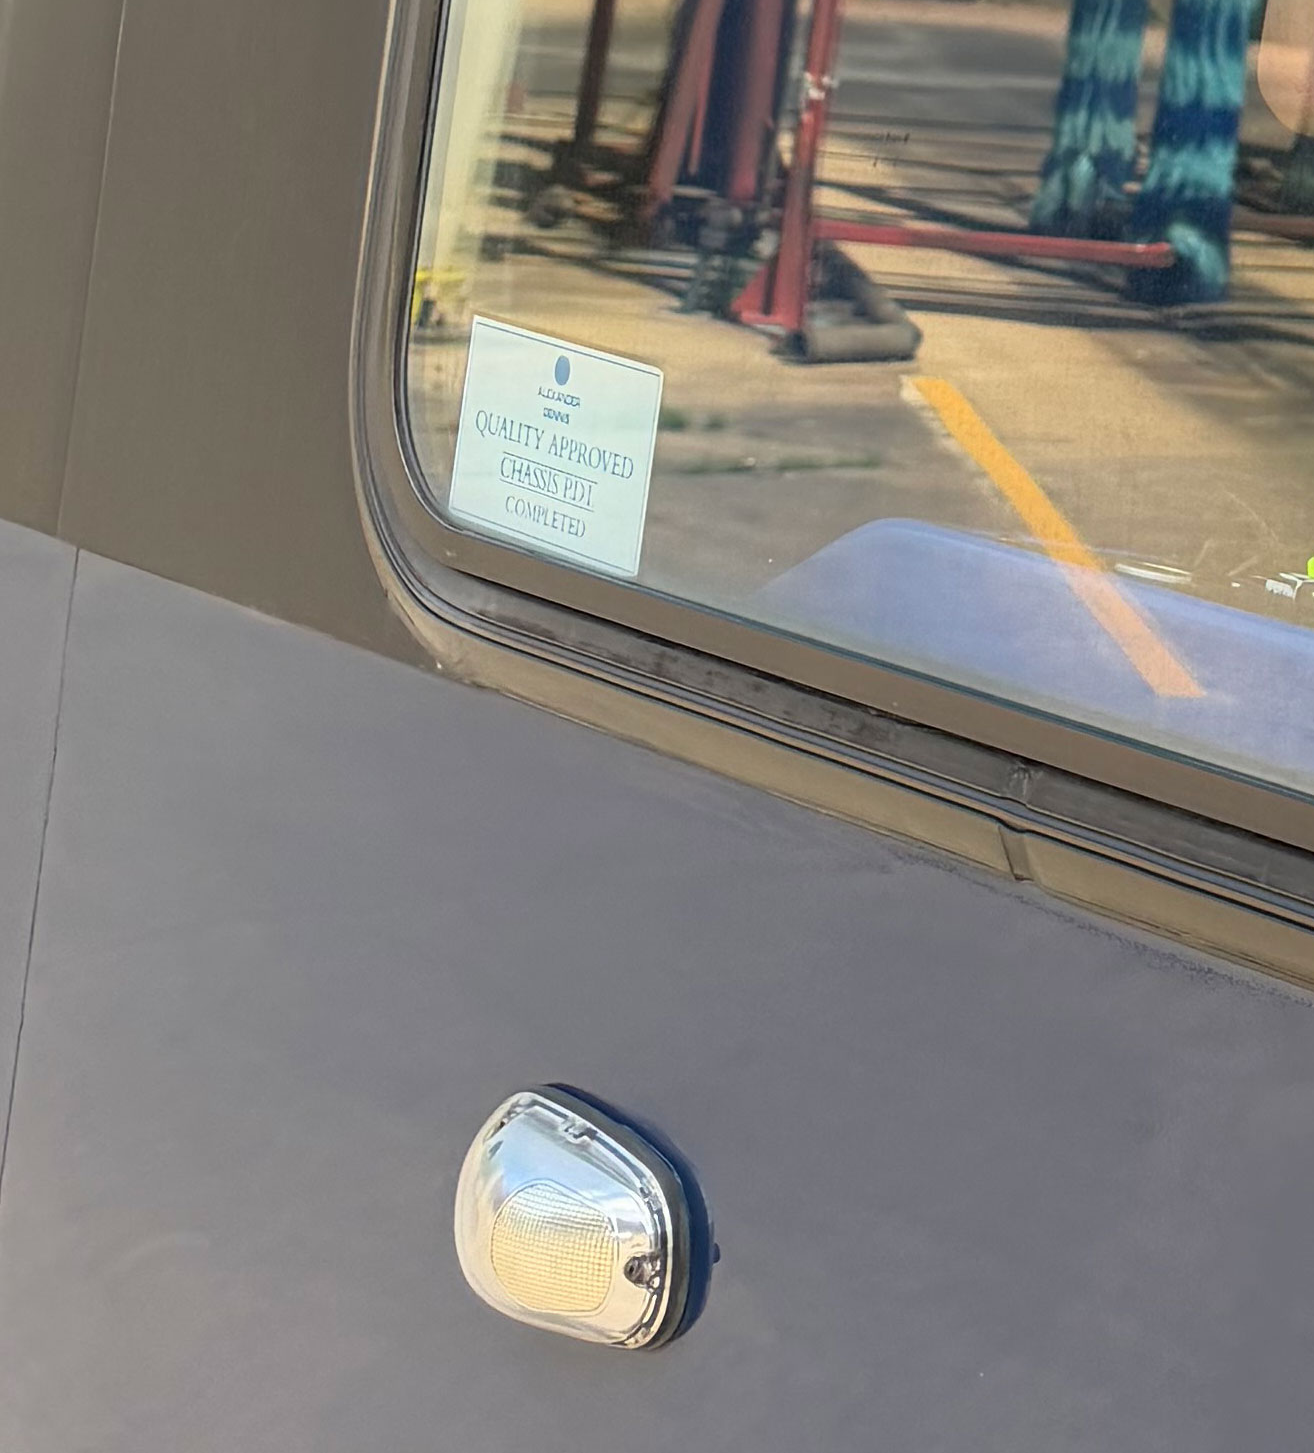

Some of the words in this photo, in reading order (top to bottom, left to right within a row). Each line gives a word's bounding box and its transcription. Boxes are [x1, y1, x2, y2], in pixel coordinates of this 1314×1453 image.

[474, 409, 545, 451] QUALITY
[548, 434, 635, 480] APPROVED
[500, 456, 559, 495] CHASSIS
[505, 496, 586, 539] COMPLETED
